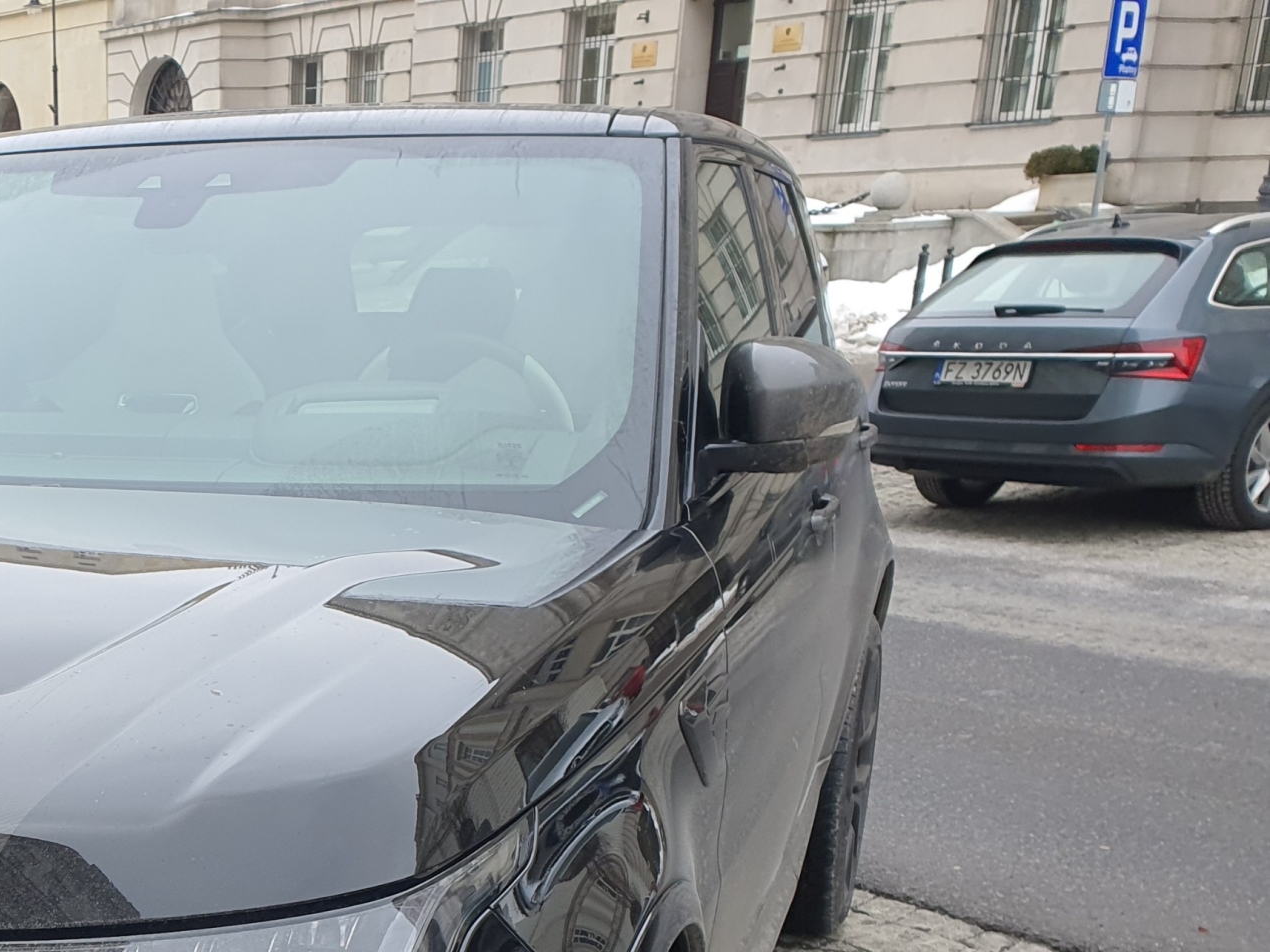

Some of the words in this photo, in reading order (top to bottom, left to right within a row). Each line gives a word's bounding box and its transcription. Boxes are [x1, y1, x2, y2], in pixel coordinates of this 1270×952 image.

[1115, 1, 1140, 53] P
[944, 362, 967, 380] FZ
[971, 362, 1027, 381] 3769N
